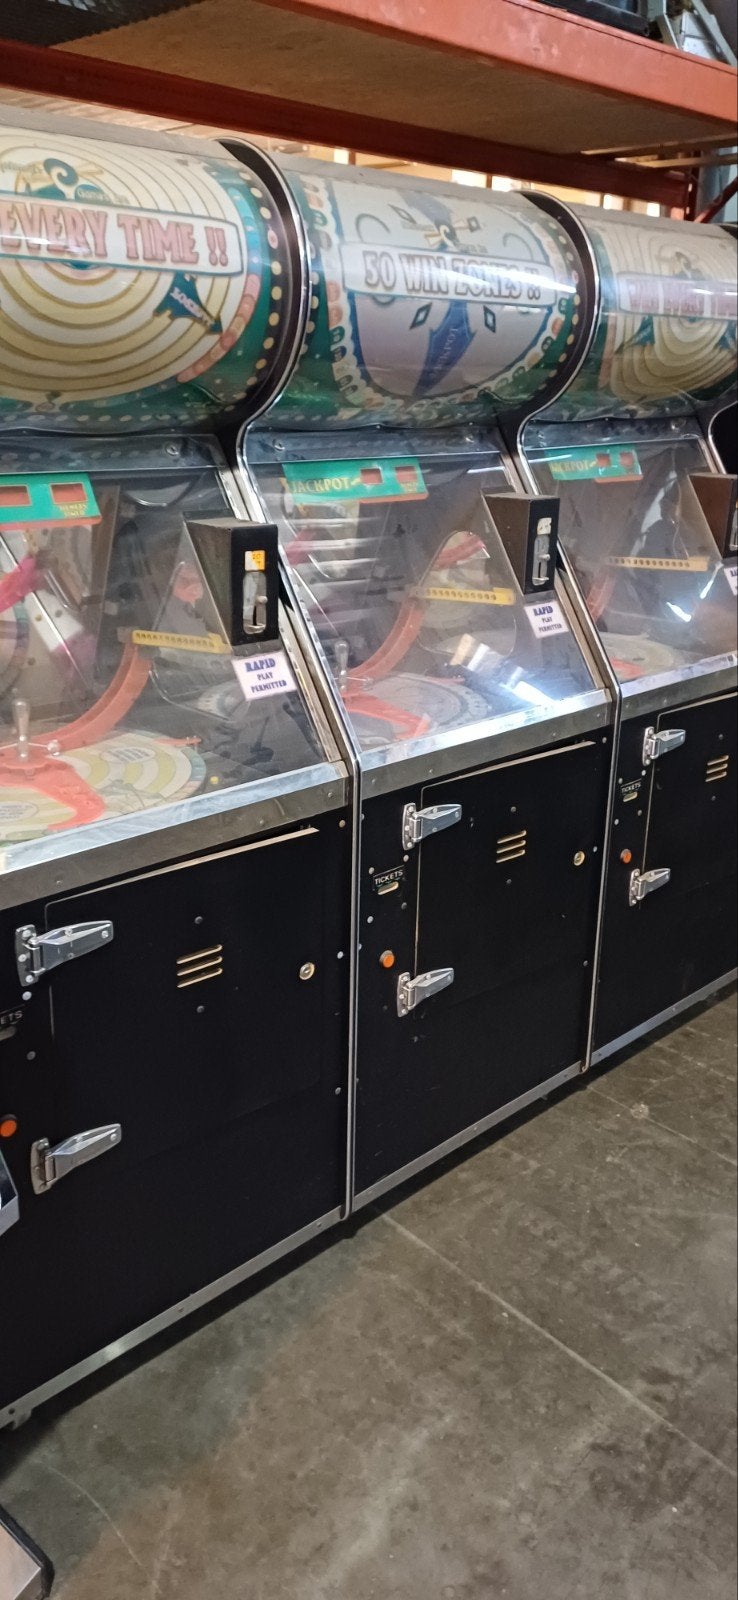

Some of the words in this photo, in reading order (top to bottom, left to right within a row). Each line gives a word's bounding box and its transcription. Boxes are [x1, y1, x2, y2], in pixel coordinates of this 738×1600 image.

[0, 200, 108, 257] EVERY
[116, 213, 199, 264] TIME
[204, 226, 229, 267] !!
[362, 250, 397, 291] 50
[400, 253, 449, 295] WIN
[291, 477, 349, 493] JACKPOT
[533, 605, 554, 616] RAPID
[245, 657, 276, 672] RAPID
[257, 671, 274, 681] PLAY
[251, 679, 288, 693] PERMITTED
[374, 869, 404, 885] TICKETS
